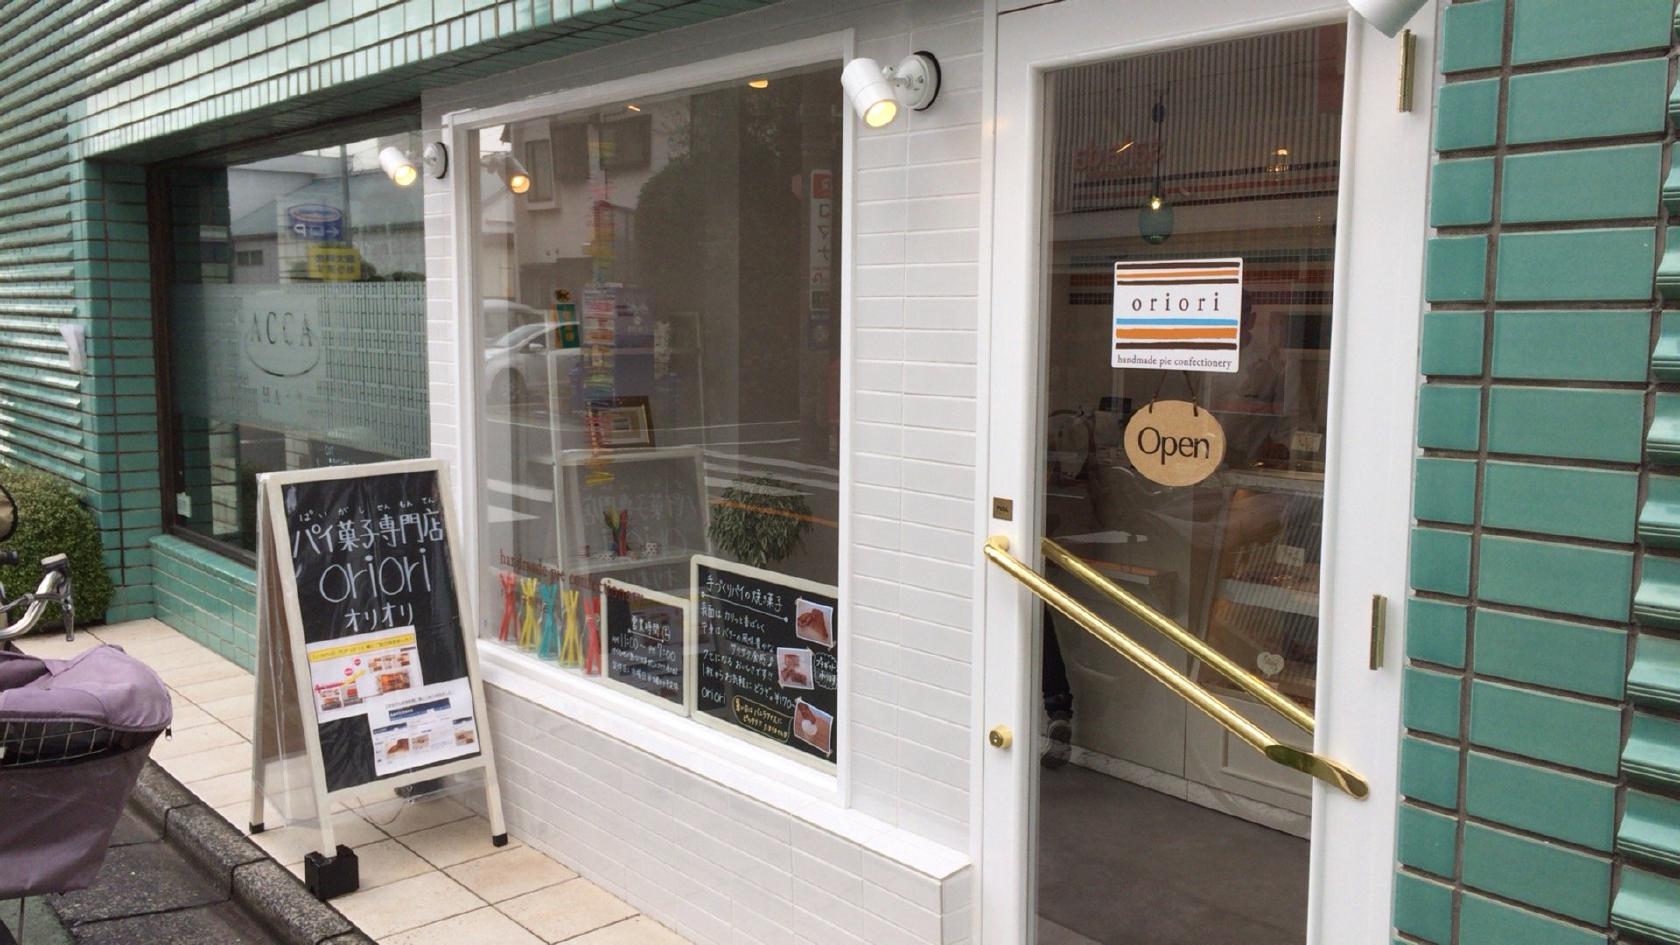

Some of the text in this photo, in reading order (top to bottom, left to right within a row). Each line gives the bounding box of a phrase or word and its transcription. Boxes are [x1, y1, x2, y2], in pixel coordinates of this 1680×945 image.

[1132, 291, 1219, 312] oriori
[249, 311, 313, 347] ACCA
[1117, 354, 1232, 370] handmade pie confectionery
[1137, 426, 1210, 465] Open
[293, 507, 444, 558] パイ菓子専門店
[319, 547, 431, 603] oriori
[344, 602, 413, 632] オリオリ
